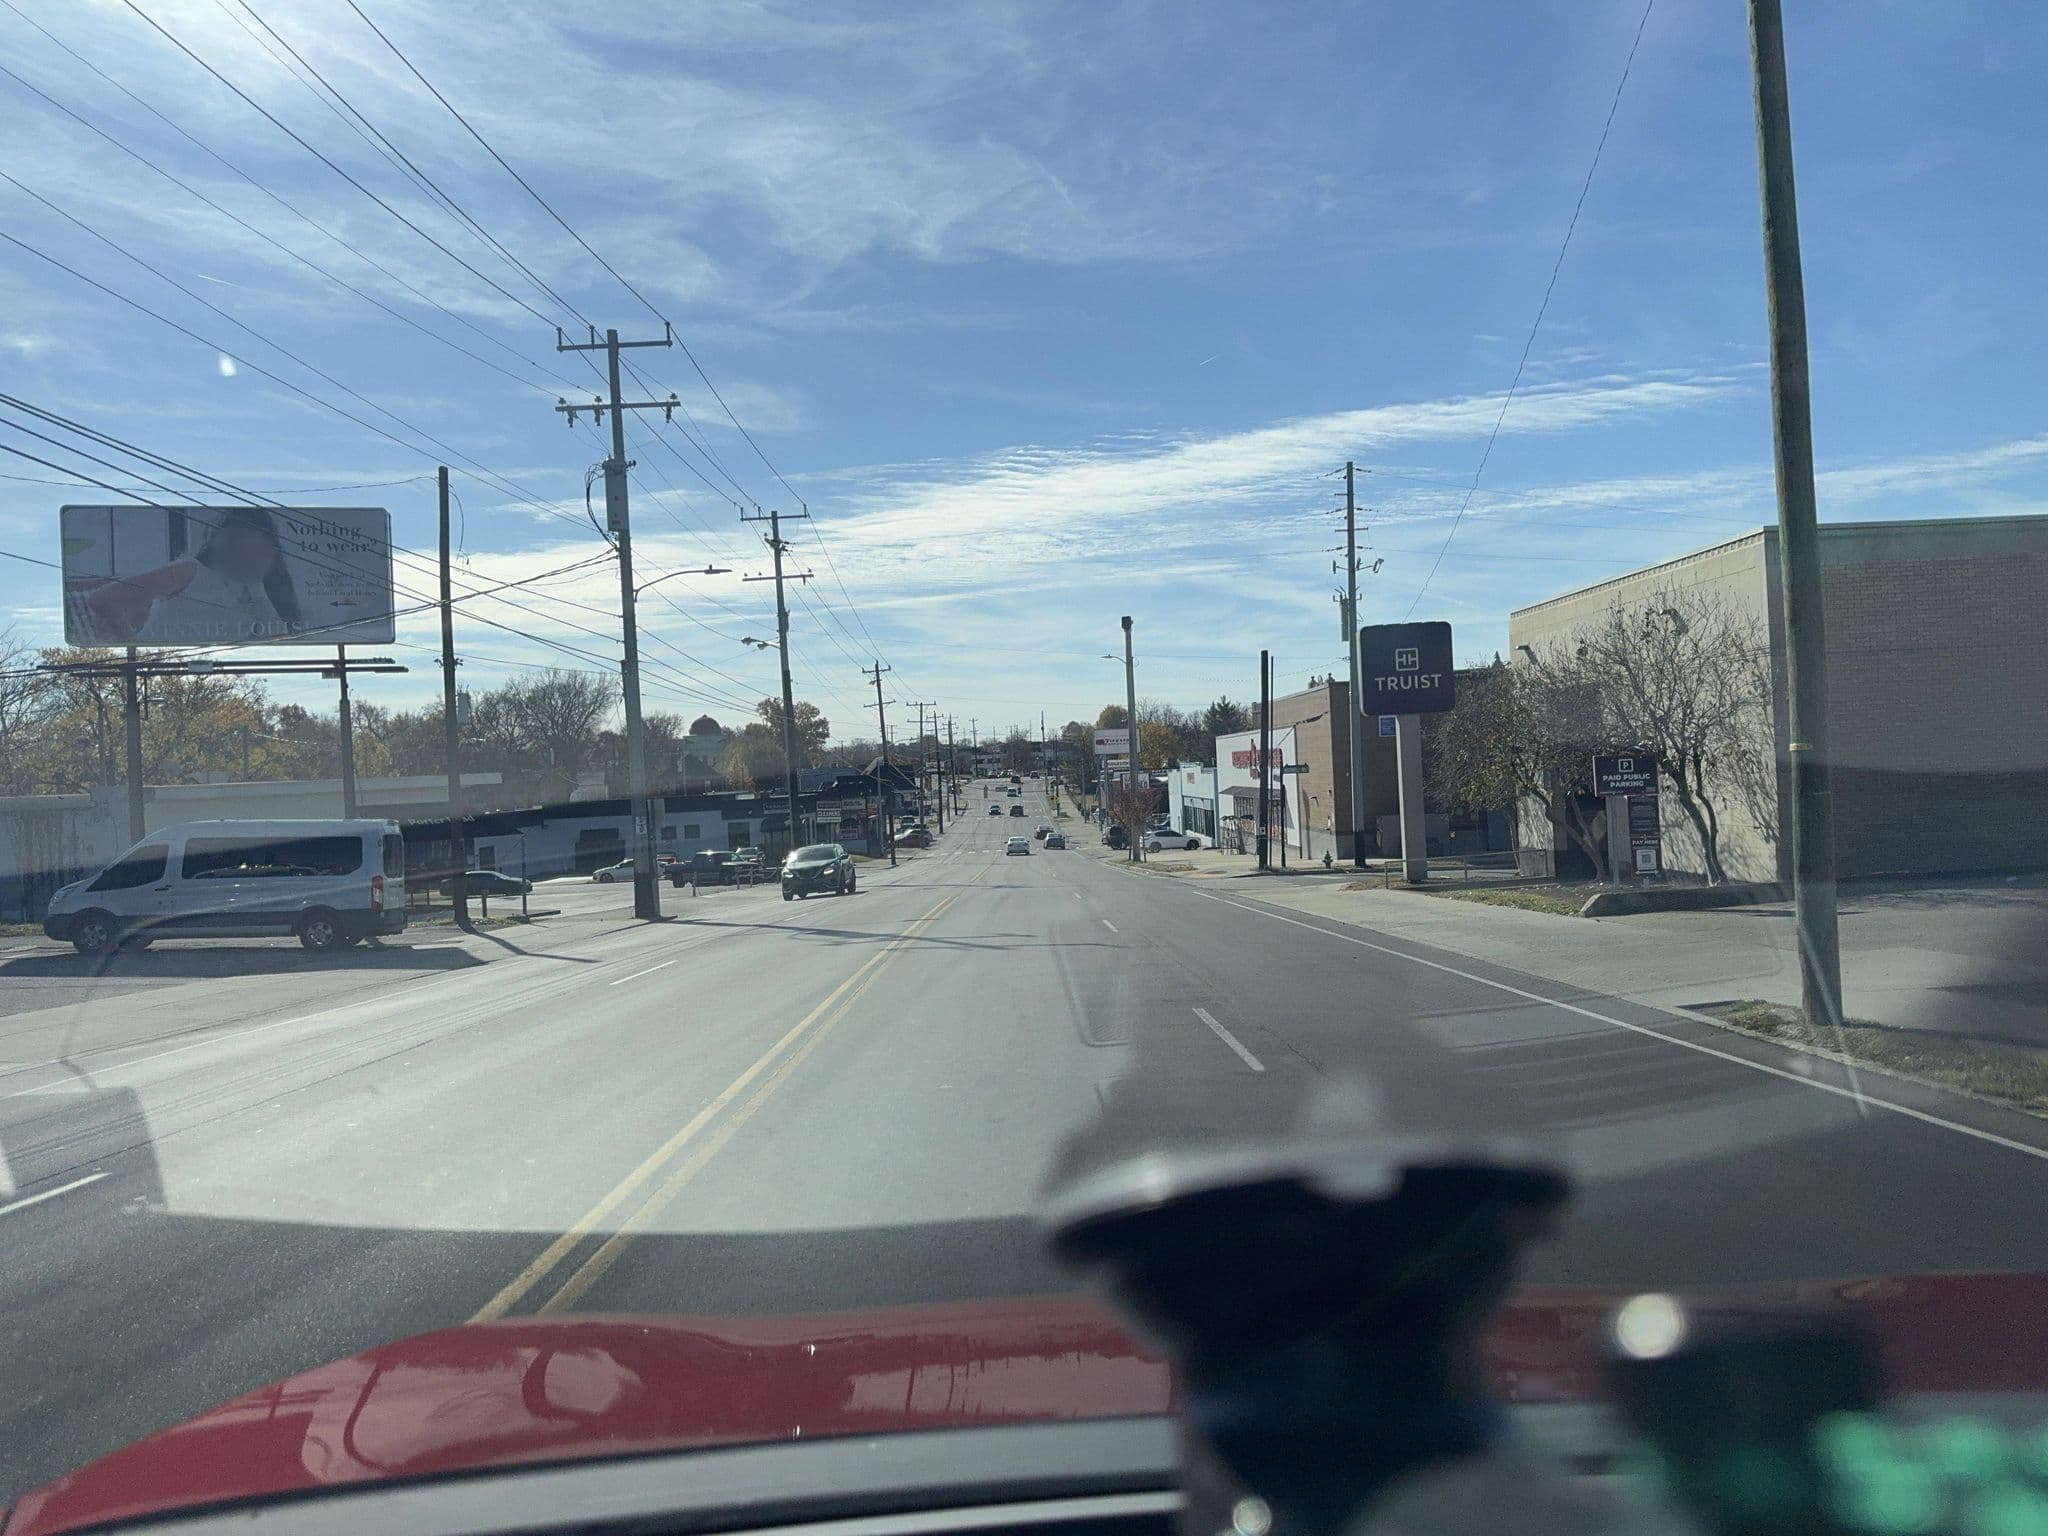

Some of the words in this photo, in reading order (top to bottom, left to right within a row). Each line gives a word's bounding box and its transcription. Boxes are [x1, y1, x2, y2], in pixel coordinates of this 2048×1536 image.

[287, 520, 362, 541] Nothing
[301, 540, 319, 552] to
[1374, 674, 1442, 692] TRUIST
[1610, 780, 1644, 788] PARKING
